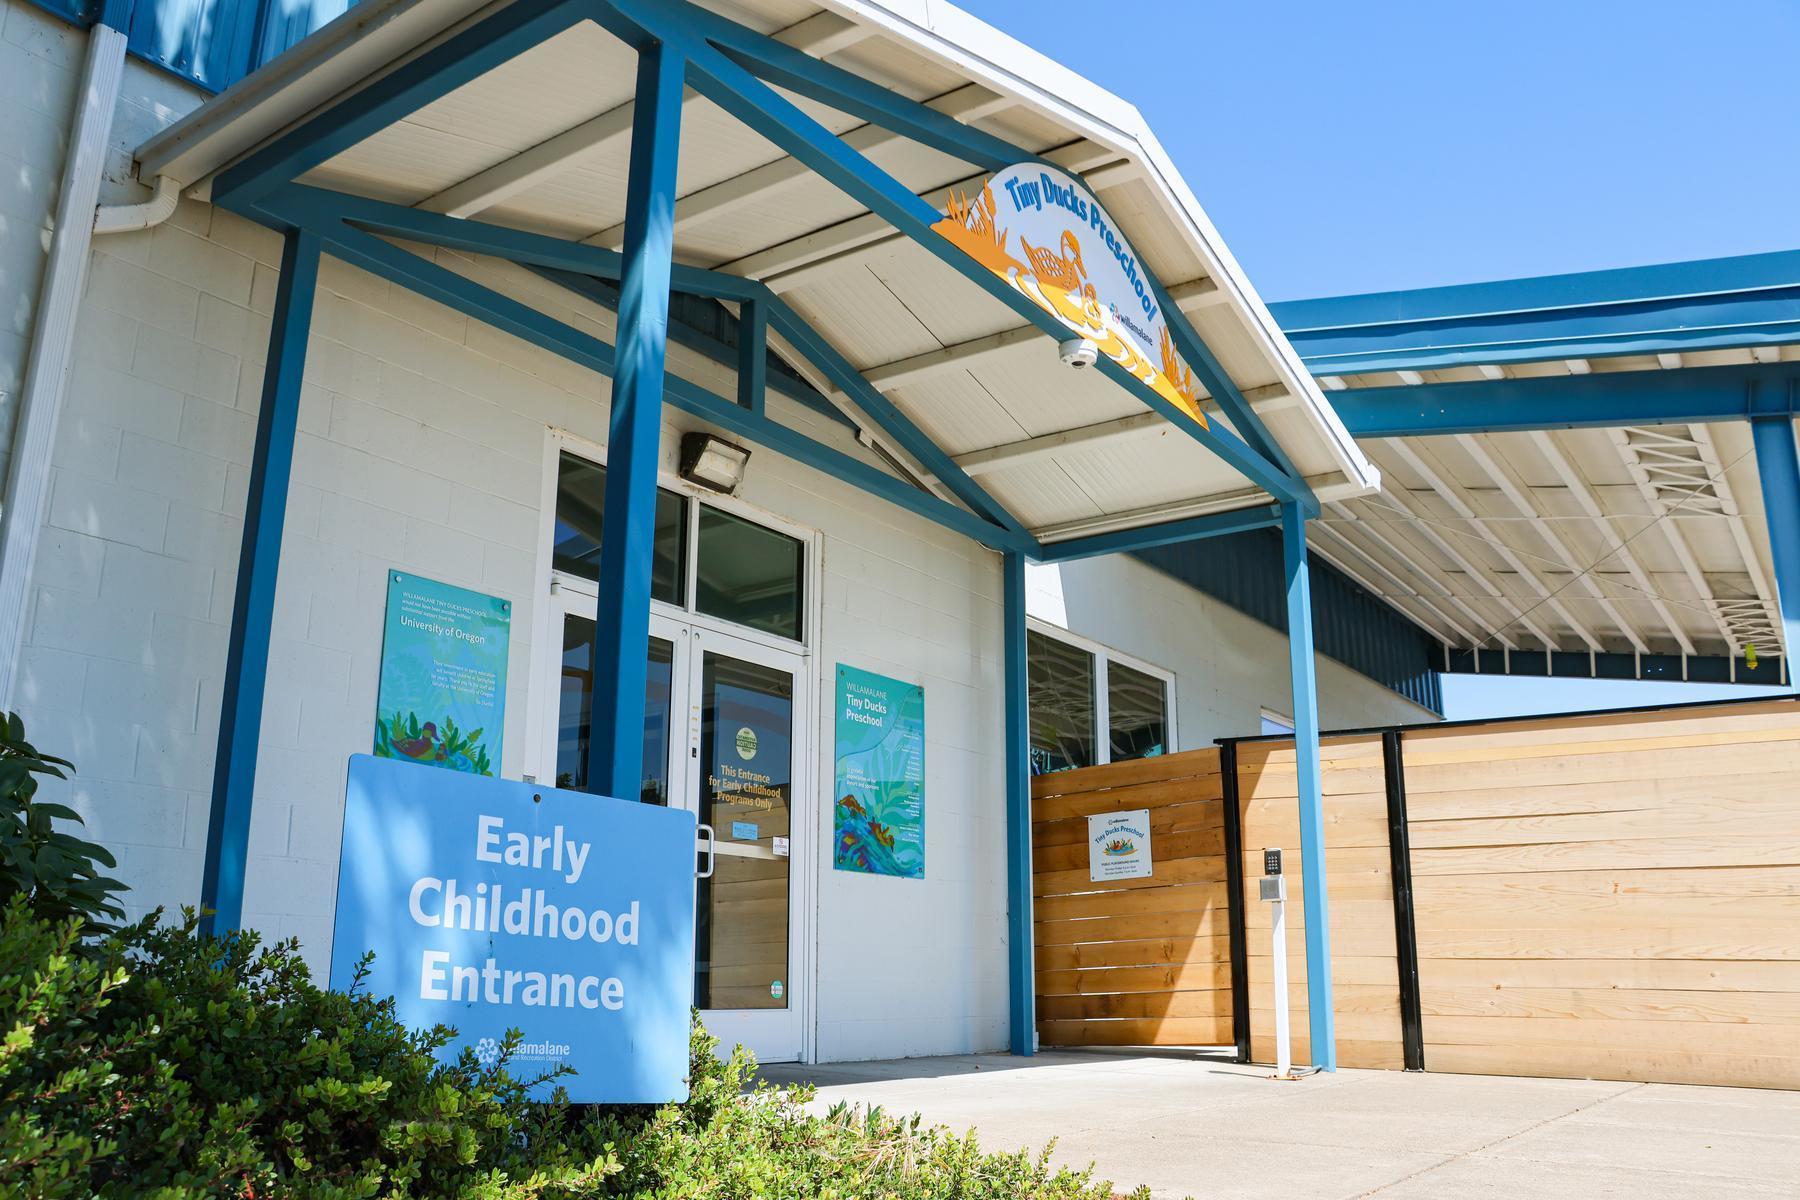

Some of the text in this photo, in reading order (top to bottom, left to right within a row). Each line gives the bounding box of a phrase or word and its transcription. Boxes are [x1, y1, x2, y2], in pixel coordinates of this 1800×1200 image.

[1005, 172, 1157, 322] Tiny Ducks Preschool
[1120, 314, 1152, 346] willamalane
[402, 591, 436, 604] WILLAMALANE
[446, 602, 462, 611] DUCKS
[463, 606, 488, 617] PRESCHOOL
[401, 616, 484, 644] University of Oregon
[846, 681, 887, 700] WILLAMALANE
[846, 693, 887, 714] Tiny Ducks
[846, 708, 883, 727] Preschool
[721, 764, 770, 784] This Entrance
[708, 775, 780, 798] for Early Childhood
[717, 791, 772, 812] Programs Only
[1095, 826, 1144, 844] Tiny Ducks Preschool
[476, 814, 591, 884] Early
[408, 876, 640, 946] Childhood
[420, 950, 624, 1010] Entrance
[520, 1054, 545, 1062] Recreation
